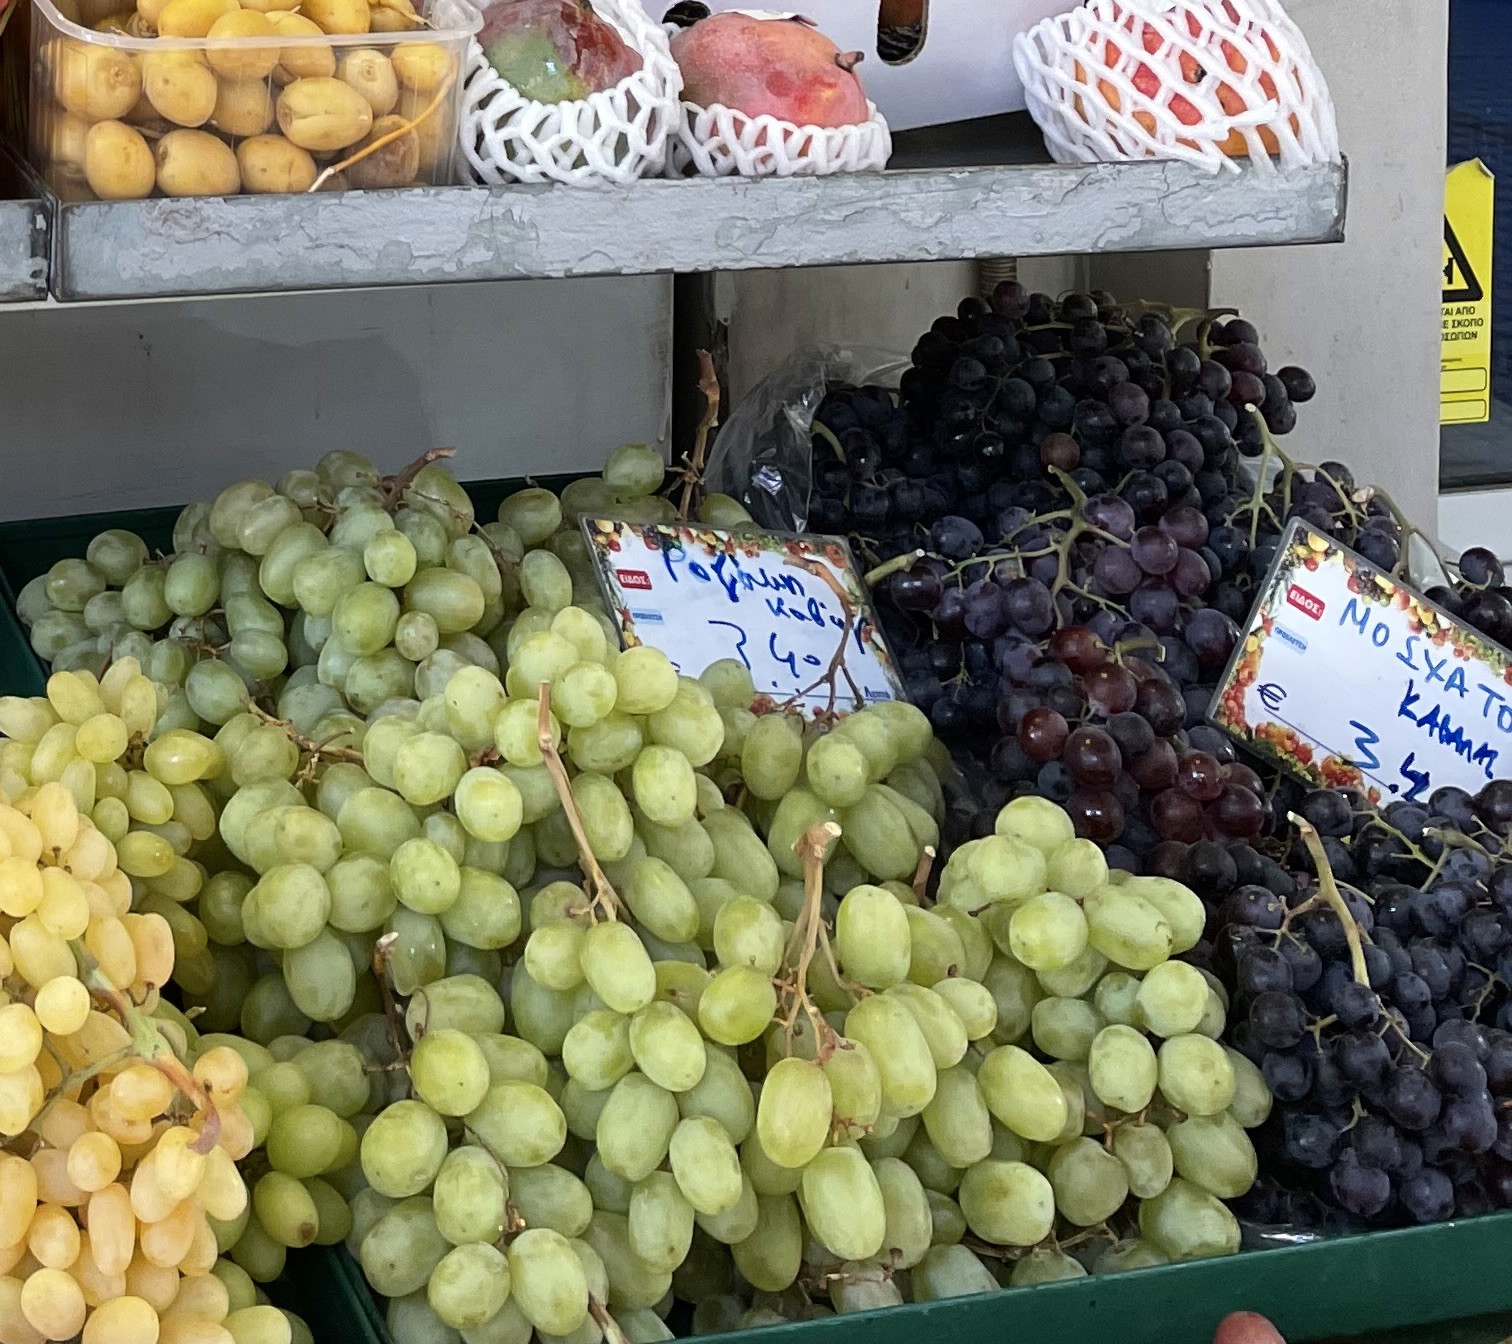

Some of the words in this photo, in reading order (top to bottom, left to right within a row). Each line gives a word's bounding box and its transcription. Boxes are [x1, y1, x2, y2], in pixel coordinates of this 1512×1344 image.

[1456, 305, 1476, 316] ΑΠΟ
[1451, 317, 1485, 328] ΣΚΟΠΟ
[619, 572, 650, 586] ΕΙΔΟΣ
[1289, 590, 1323, 618] ΕΙΔΟΣ
[1256, 682, 1288, 712] €
